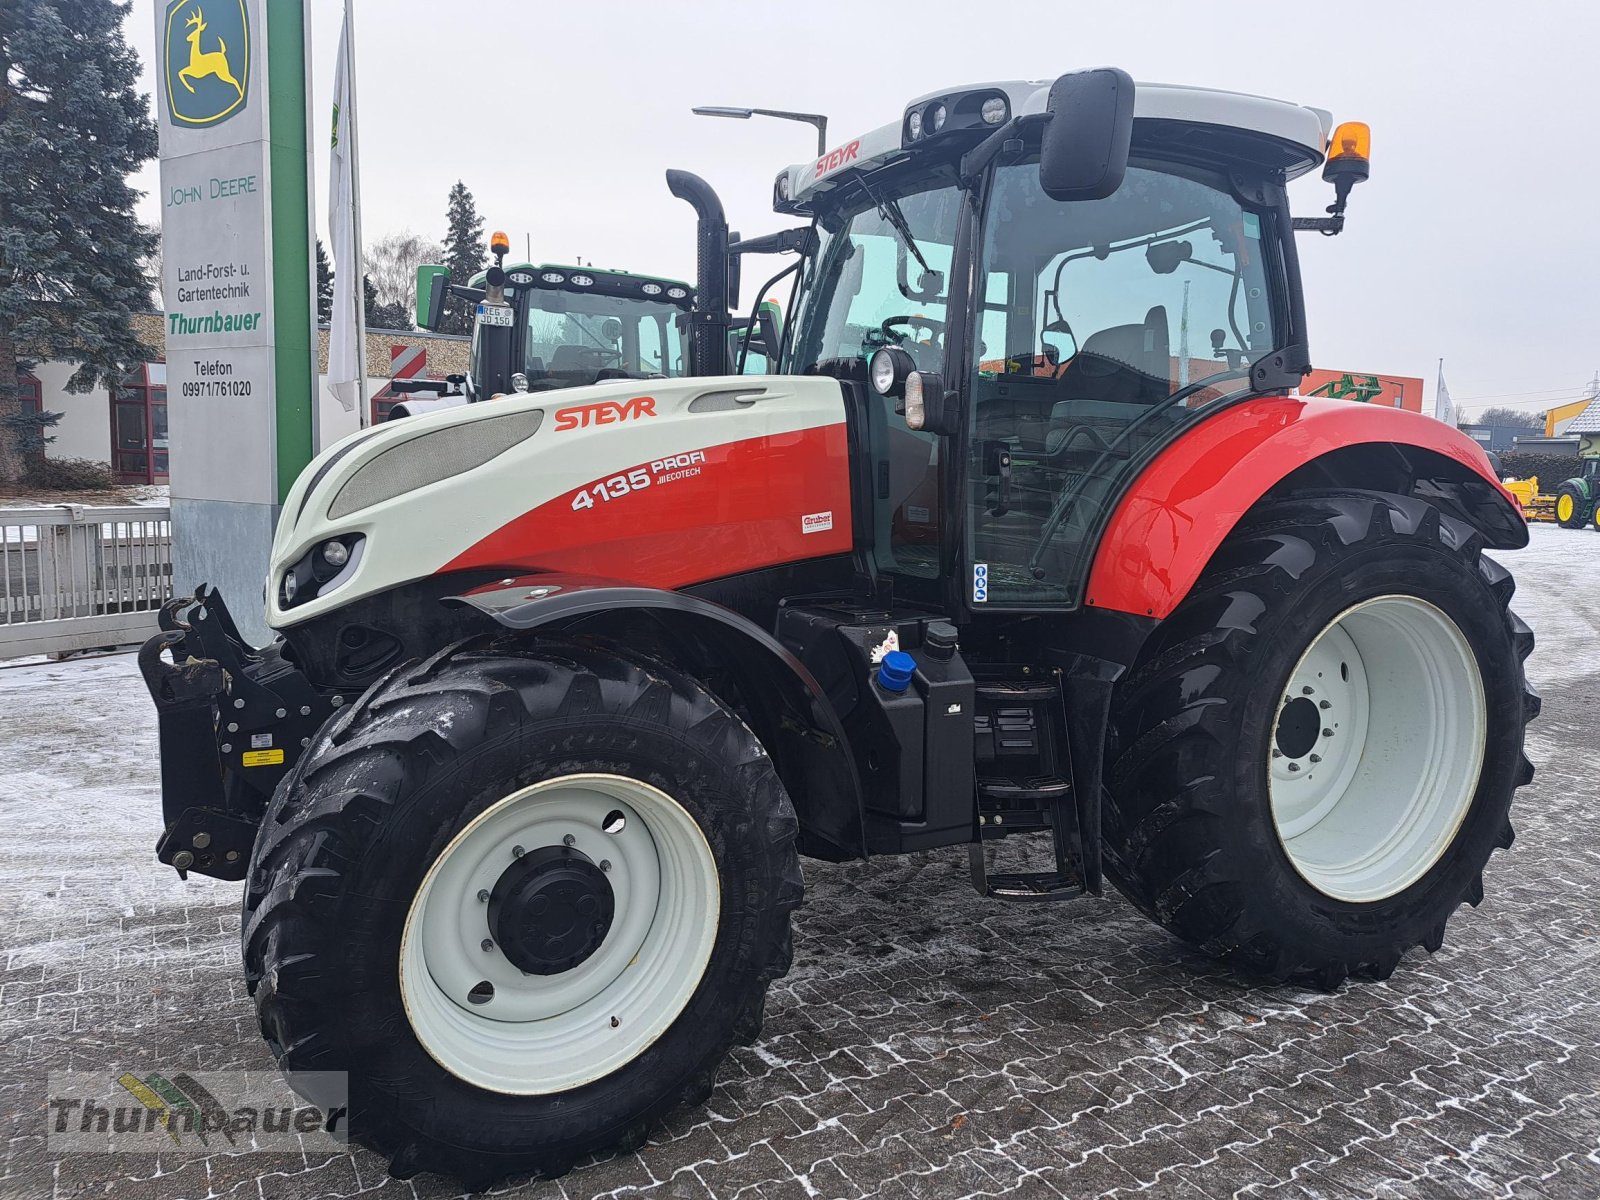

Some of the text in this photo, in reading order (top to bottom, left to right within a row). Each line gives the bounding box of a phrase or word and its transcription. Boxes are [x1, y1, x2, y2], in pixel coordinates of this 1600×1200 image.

[815, 140, 860, 179] STEYR
[167, 175, 257, 207] JOHN DEERE
[178, 262, 250, 282] Land-Forst- u.
[177, 282, 250, 303] Gartentechnik
[169, 310, 261, 335] Thurnbauer
[193, 360, 233, 376] Telefon
[182, 380, 252, 397] 09971/761020
[554, 396, 657, 432] STEYR
[571, 451, 706, 512] 4135 PROFI
[666, 467, 701, 482] ECOTECH
